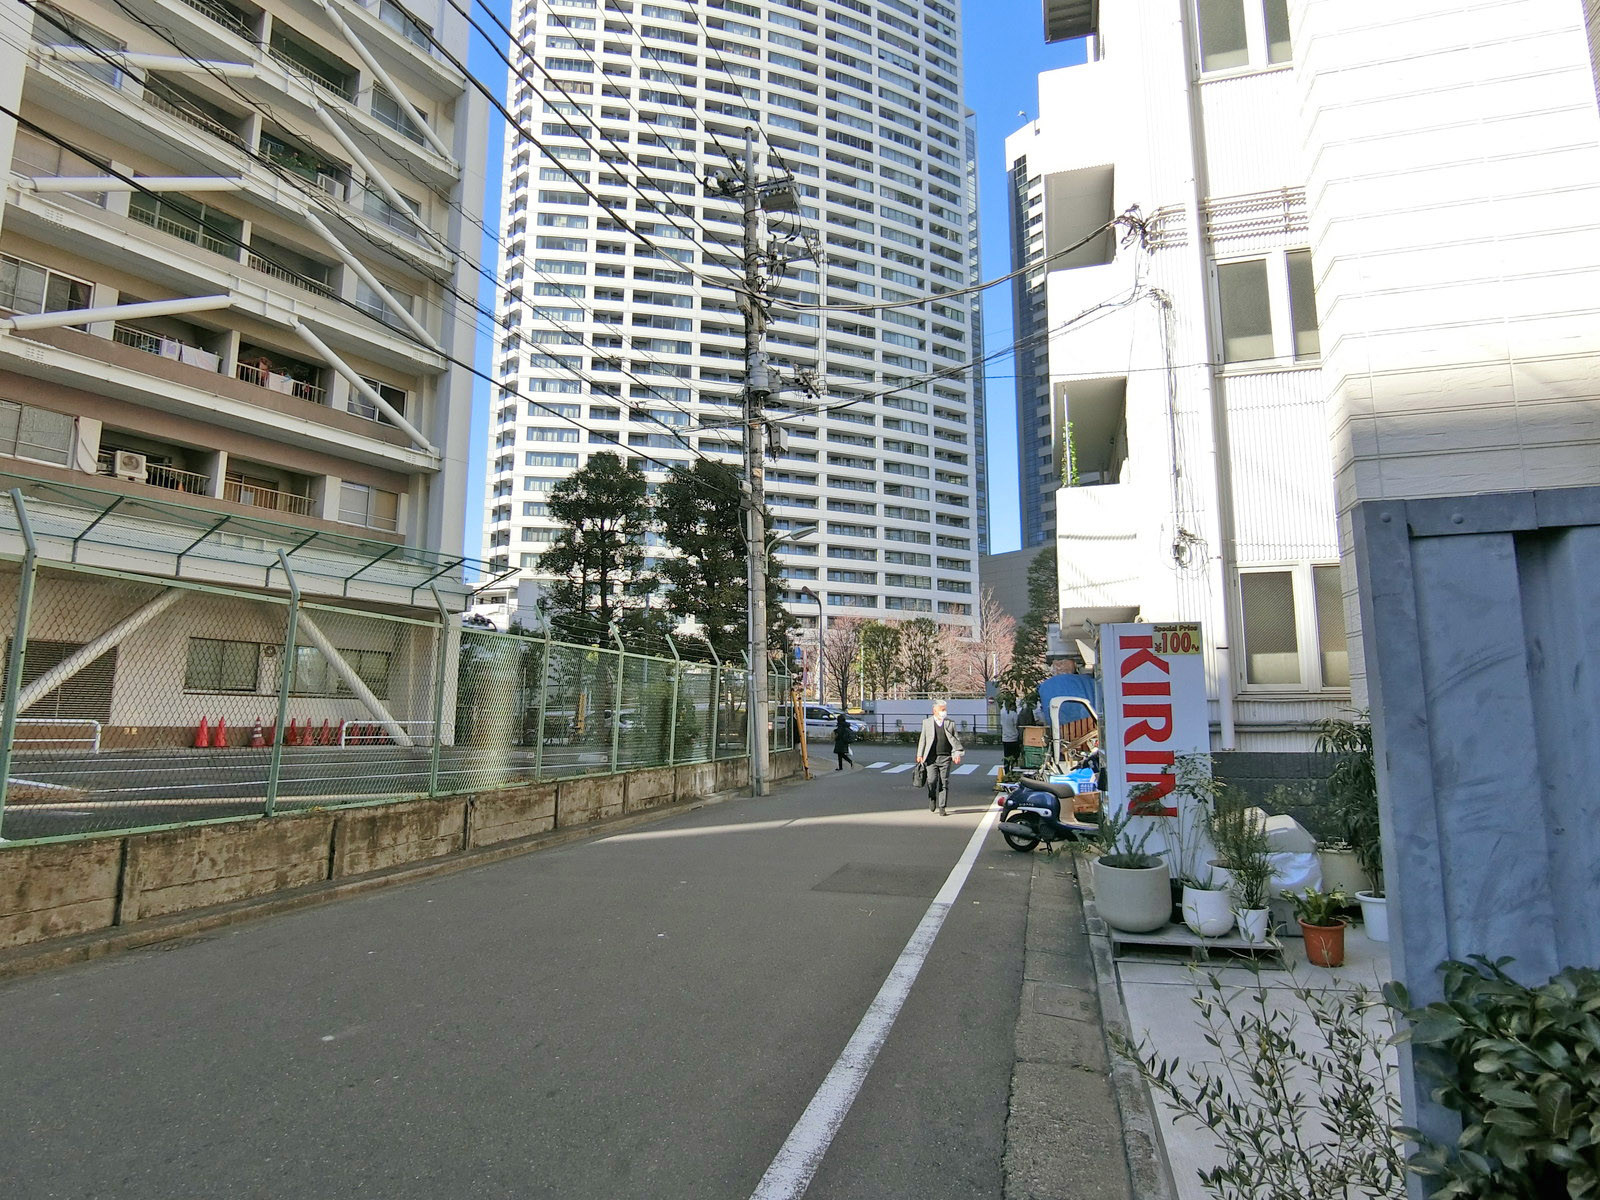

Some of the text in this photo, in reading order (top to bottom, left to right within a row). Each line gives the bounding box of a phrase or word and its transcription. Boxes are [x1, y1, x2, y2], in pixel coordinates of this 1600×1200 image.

[1153, 624, 1198, 633] Special Price
[1119, 635, 1178, 817] KIRIN
